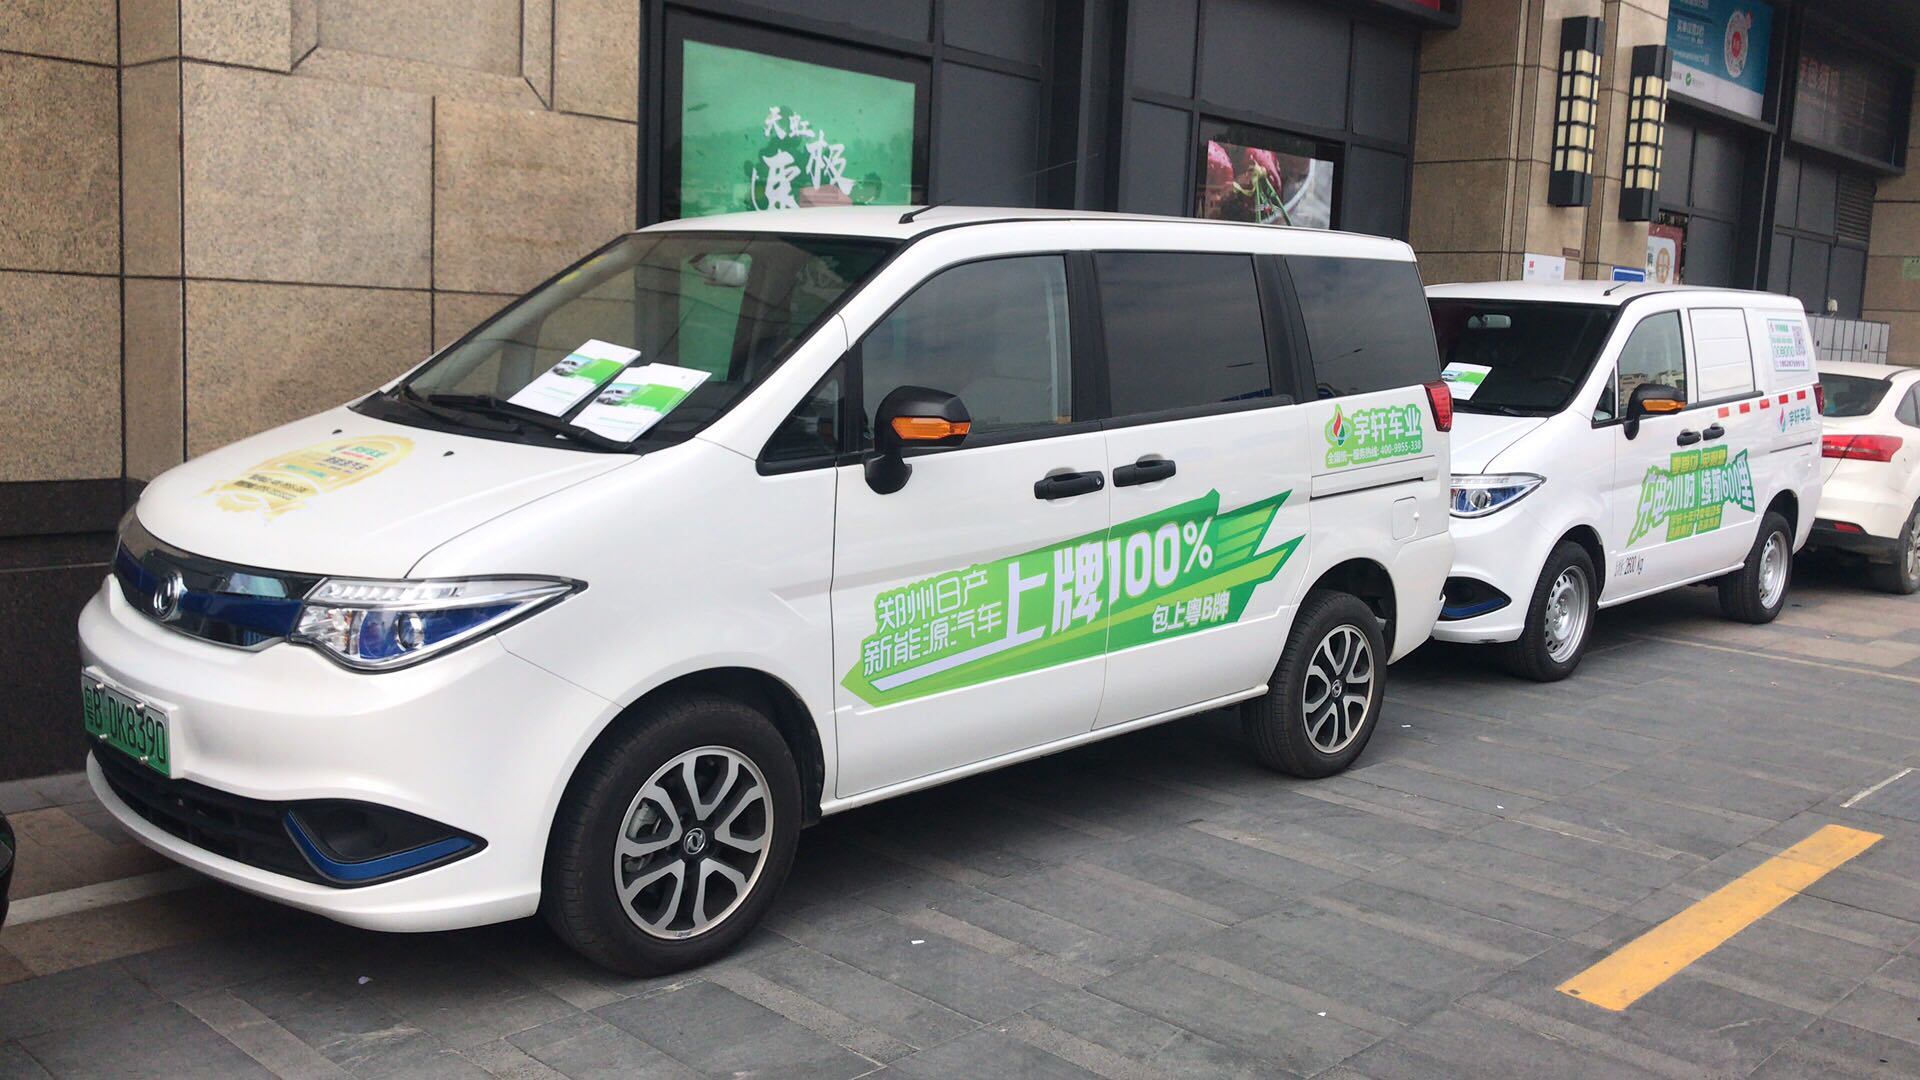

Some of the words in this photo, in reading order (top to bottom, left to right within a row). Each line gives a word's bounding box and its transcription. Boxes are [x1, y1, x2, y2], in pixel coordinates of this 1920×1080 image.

[764, 106, 816, 140] 天虹
[1353, 407, 1421, 445] 宇轩车业
[877, 569, 988, 634] 郑州日产
[1151, 589, 1231, 634] 包上粤B牌
[863, 601, 1003, 677] 新能源汽车
